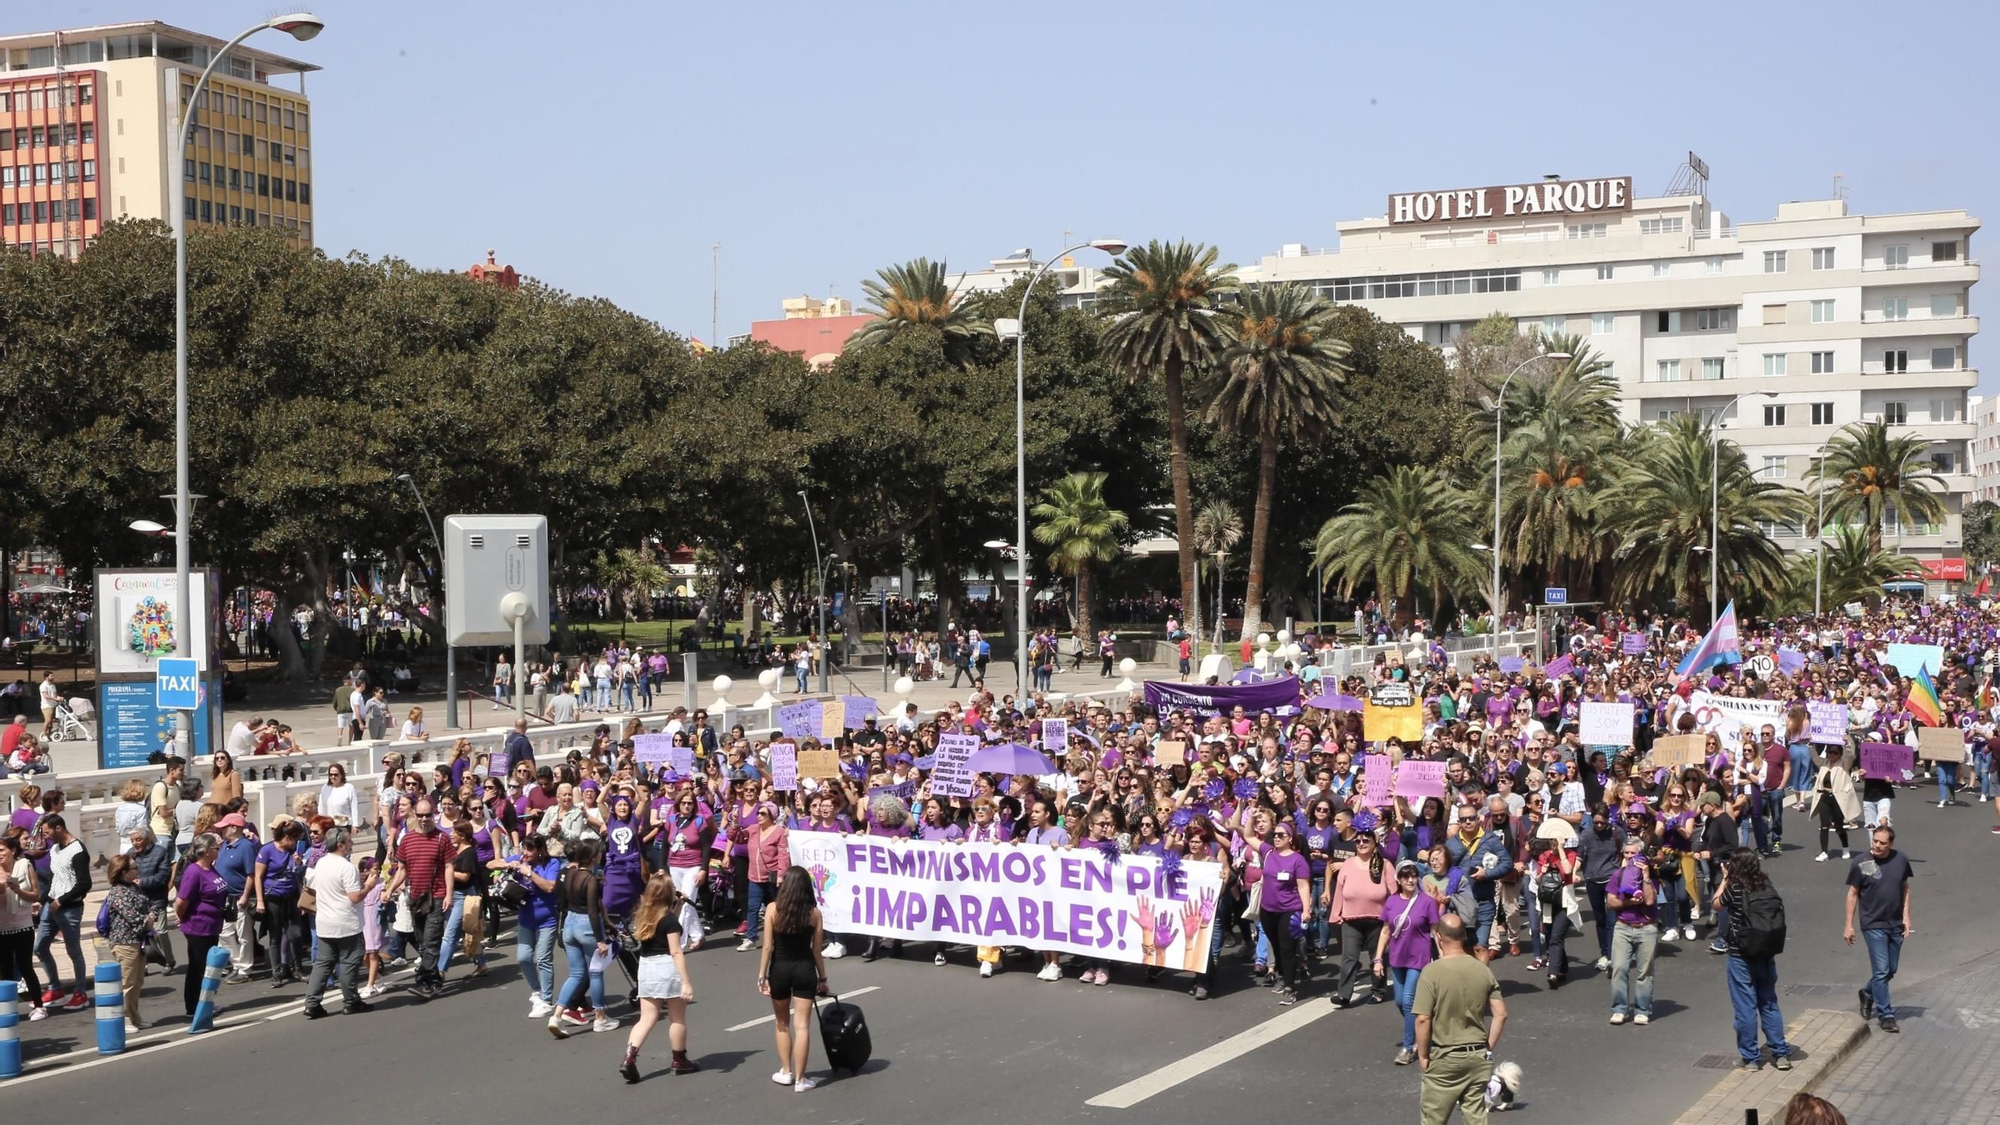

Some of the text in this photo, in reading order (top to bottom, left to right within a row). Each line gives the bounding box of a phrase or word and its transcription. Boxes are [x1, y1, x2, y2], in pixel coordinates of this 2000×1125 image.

[1393, 179, 1626, 223] HOTEL PARQUE
[1548, 592, 1564, 600] TAXI
[1752, 657, 1772, 671] NO
[160, 675, 195, 691] TAXI
[1817, 704, 1840, 712] FELIZ
[1594, 717, 1620, 728] SON
[1832, 712, 1842, 720] EL
[1823, 727, 1845, 735] FALTE
[802, 848, 836, 861] RED
[846, 844, 1047, 885] FEMINISMOS
[1060, 858, 1113, 893] EN
[852, 884, 1128, 951] ¡IMPARABLES!
